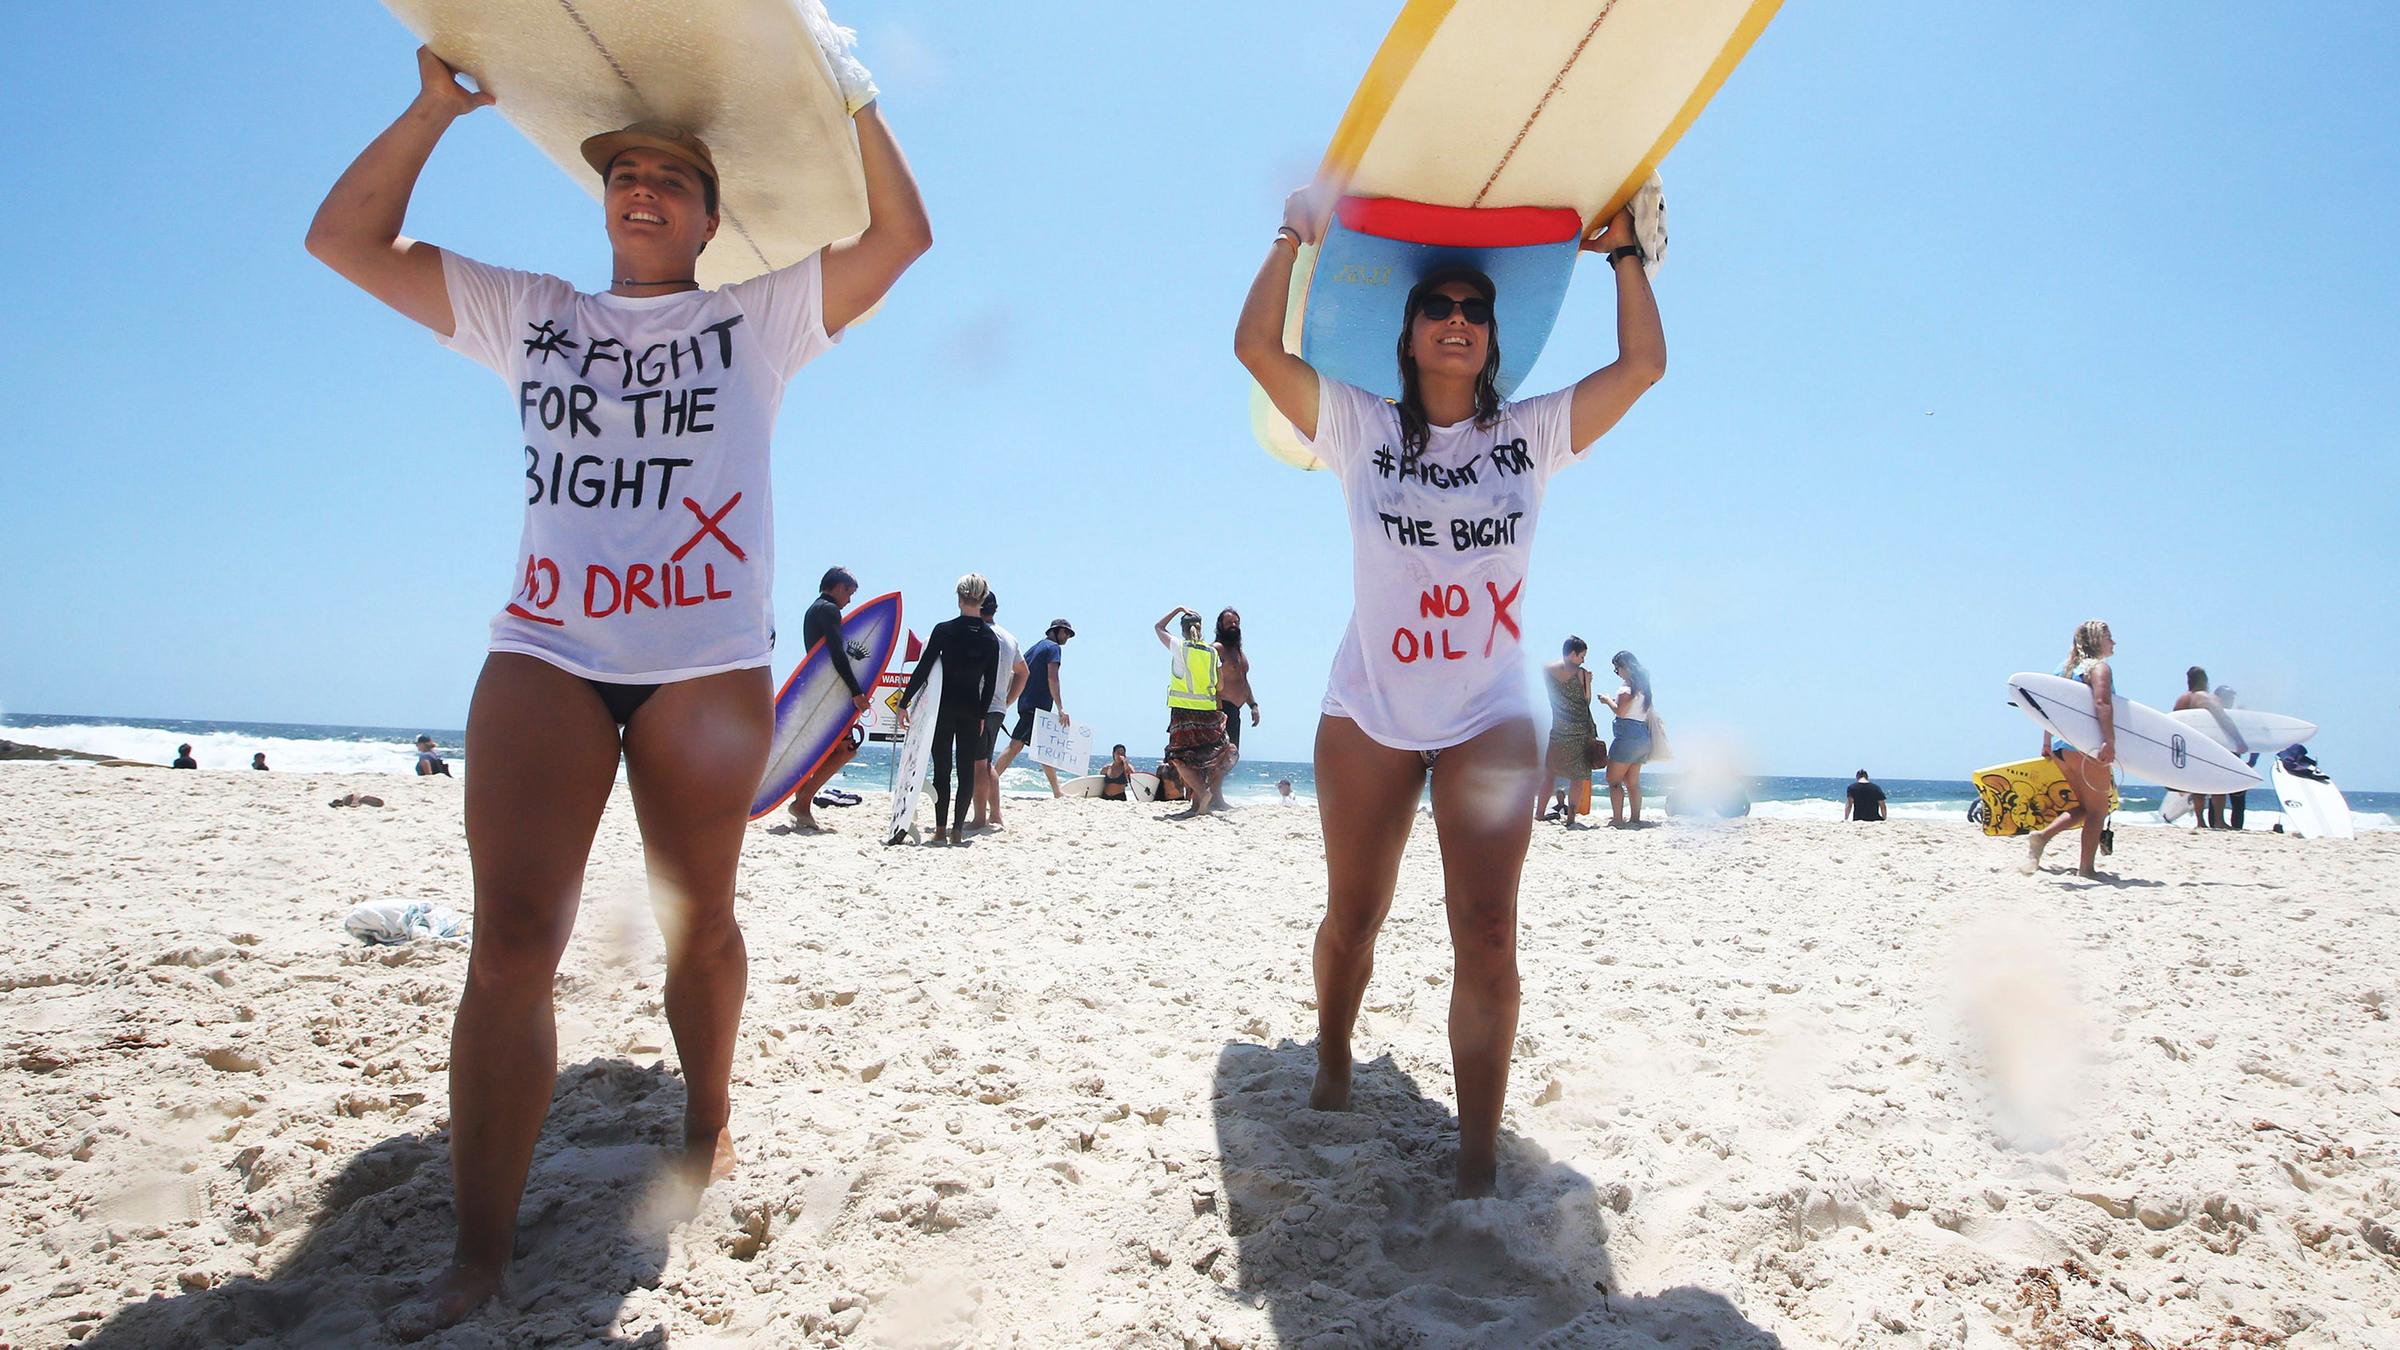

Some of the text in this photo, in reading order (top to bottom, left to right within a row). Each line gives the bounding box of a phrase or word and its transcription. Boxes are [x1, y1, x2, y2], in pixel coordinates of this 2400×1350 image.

[520, 380, 718, 438] FOR THE
[525, 445, 693, 510] BIGHT
[1489, 438, 1534, 478] FOR
[1378, 511, 1523, 551] THE BIGHT
[583, 563, 732, 618] DRILL
[1419, 584, 1470, 619] NO
[1392, 627, 1467, 663] OIL
[1036, 745, 1078, 764] TRUTH
[1050, 735, 1074, 751] THE
